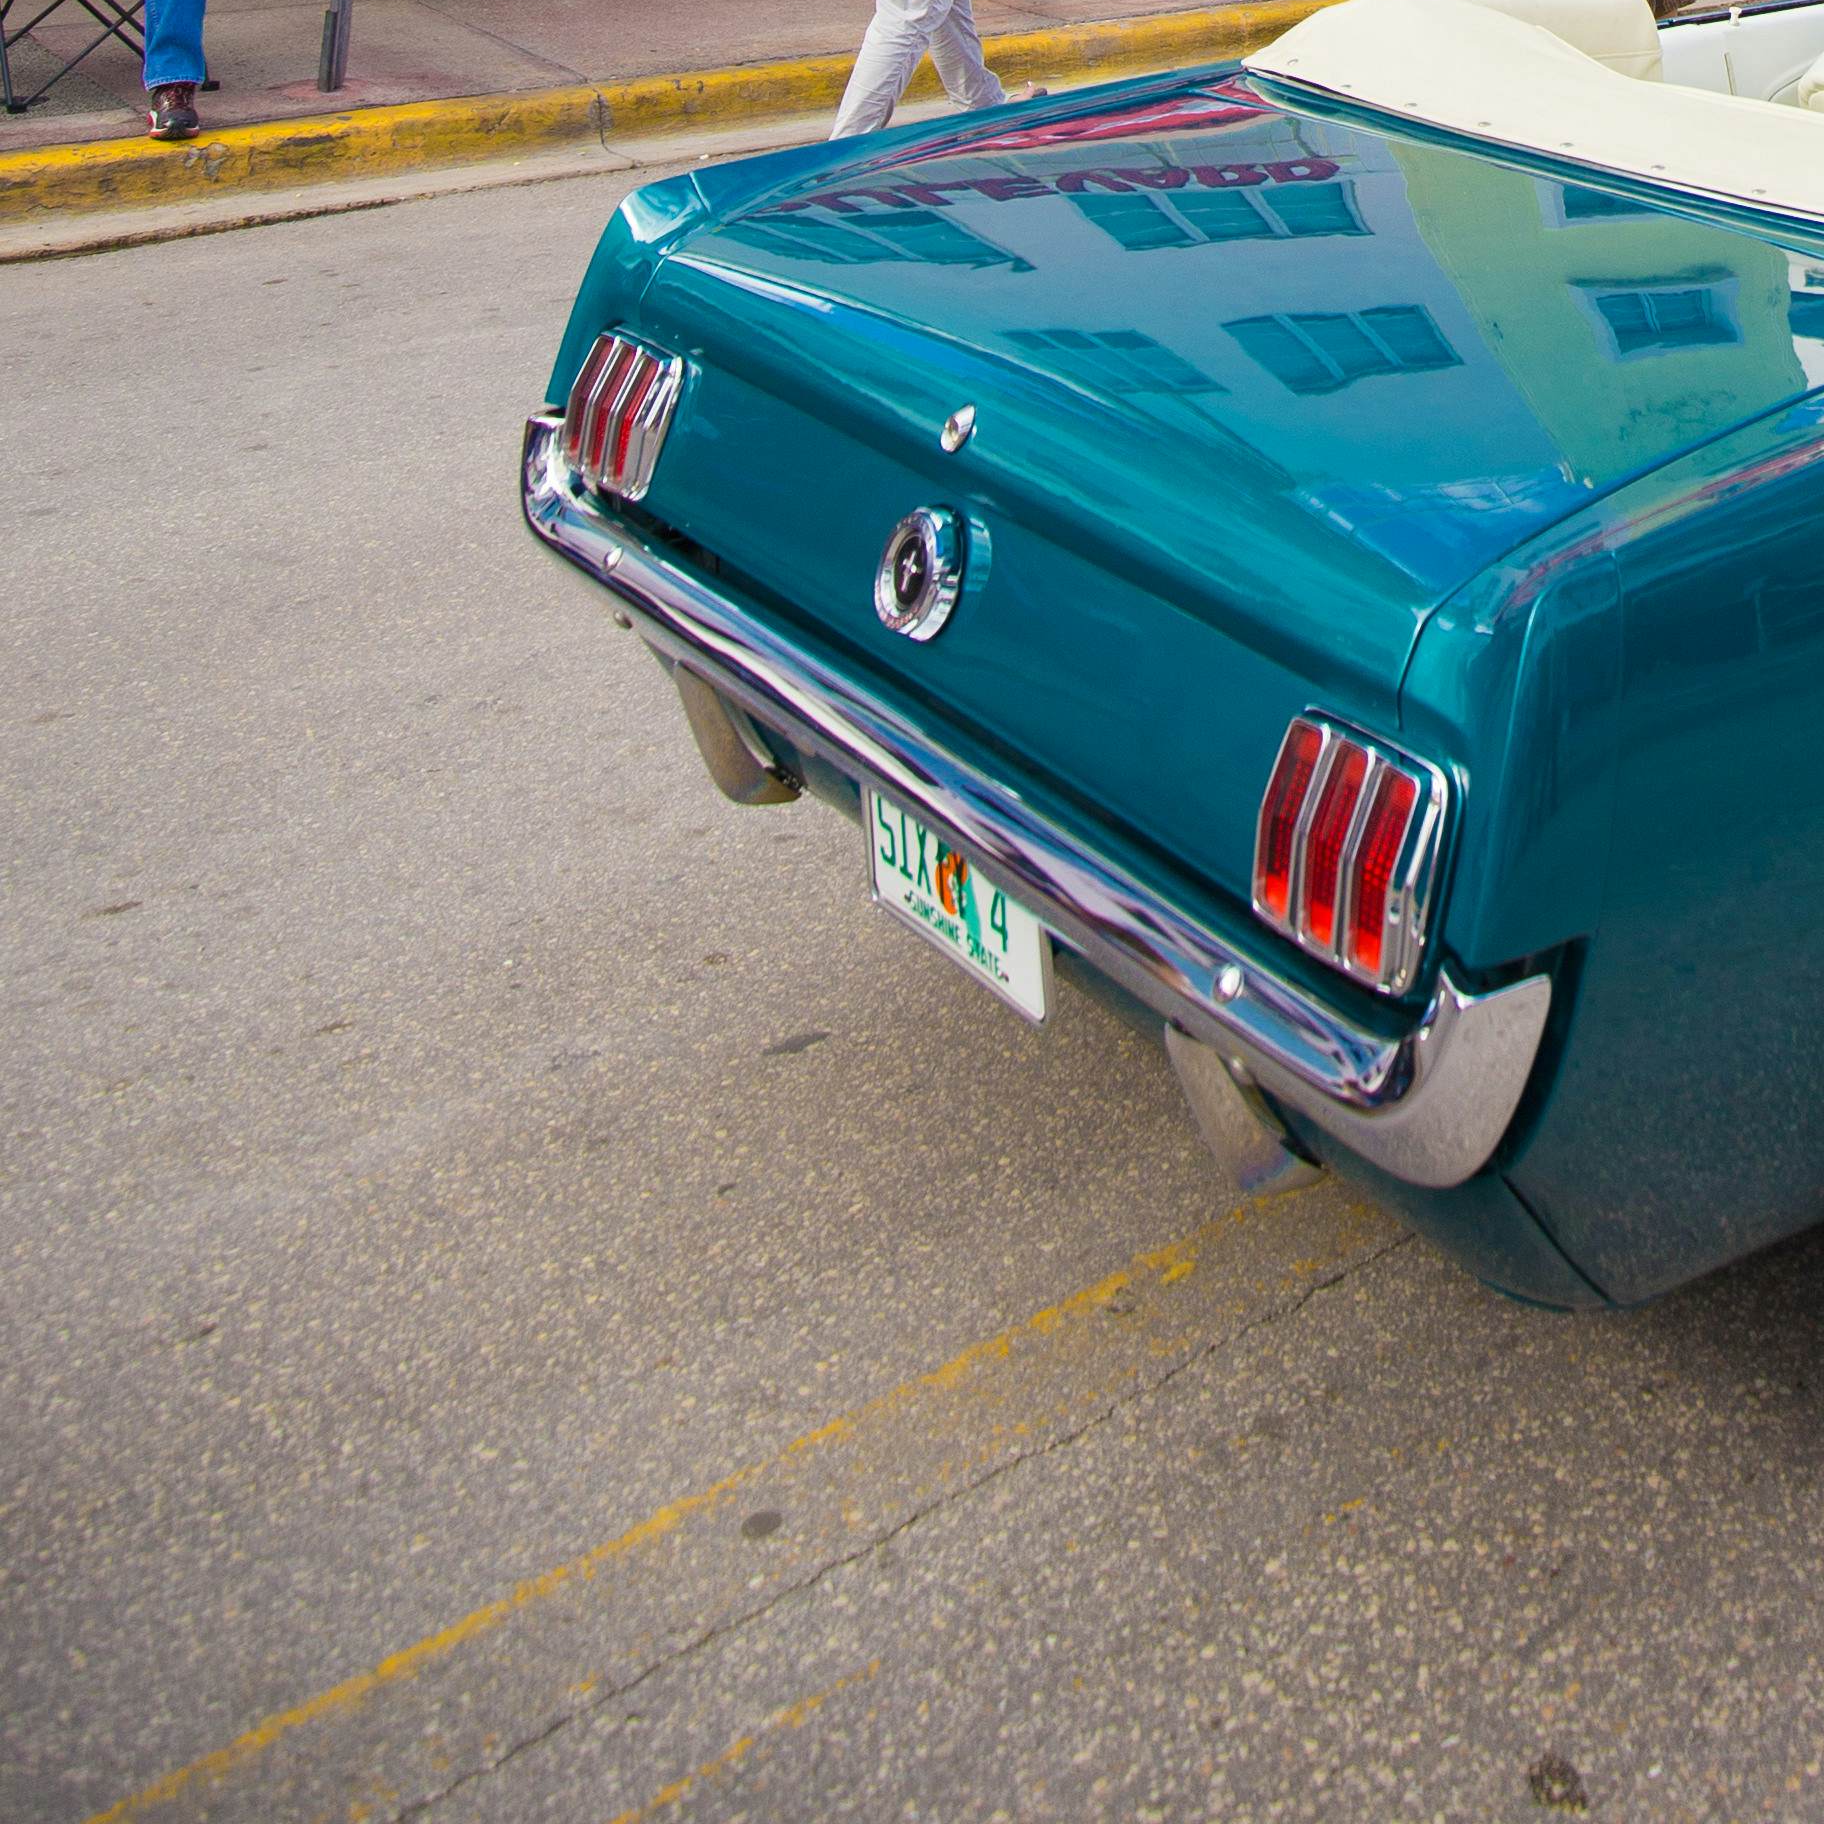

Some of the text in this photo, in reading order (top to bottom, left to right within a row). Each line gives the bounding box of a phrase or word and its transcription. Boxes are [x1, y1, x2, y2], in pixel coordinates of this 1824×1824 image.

[912, 895, 1000, 974] SUNSHINE STATE
[990, 889, 1009, 953] 4
